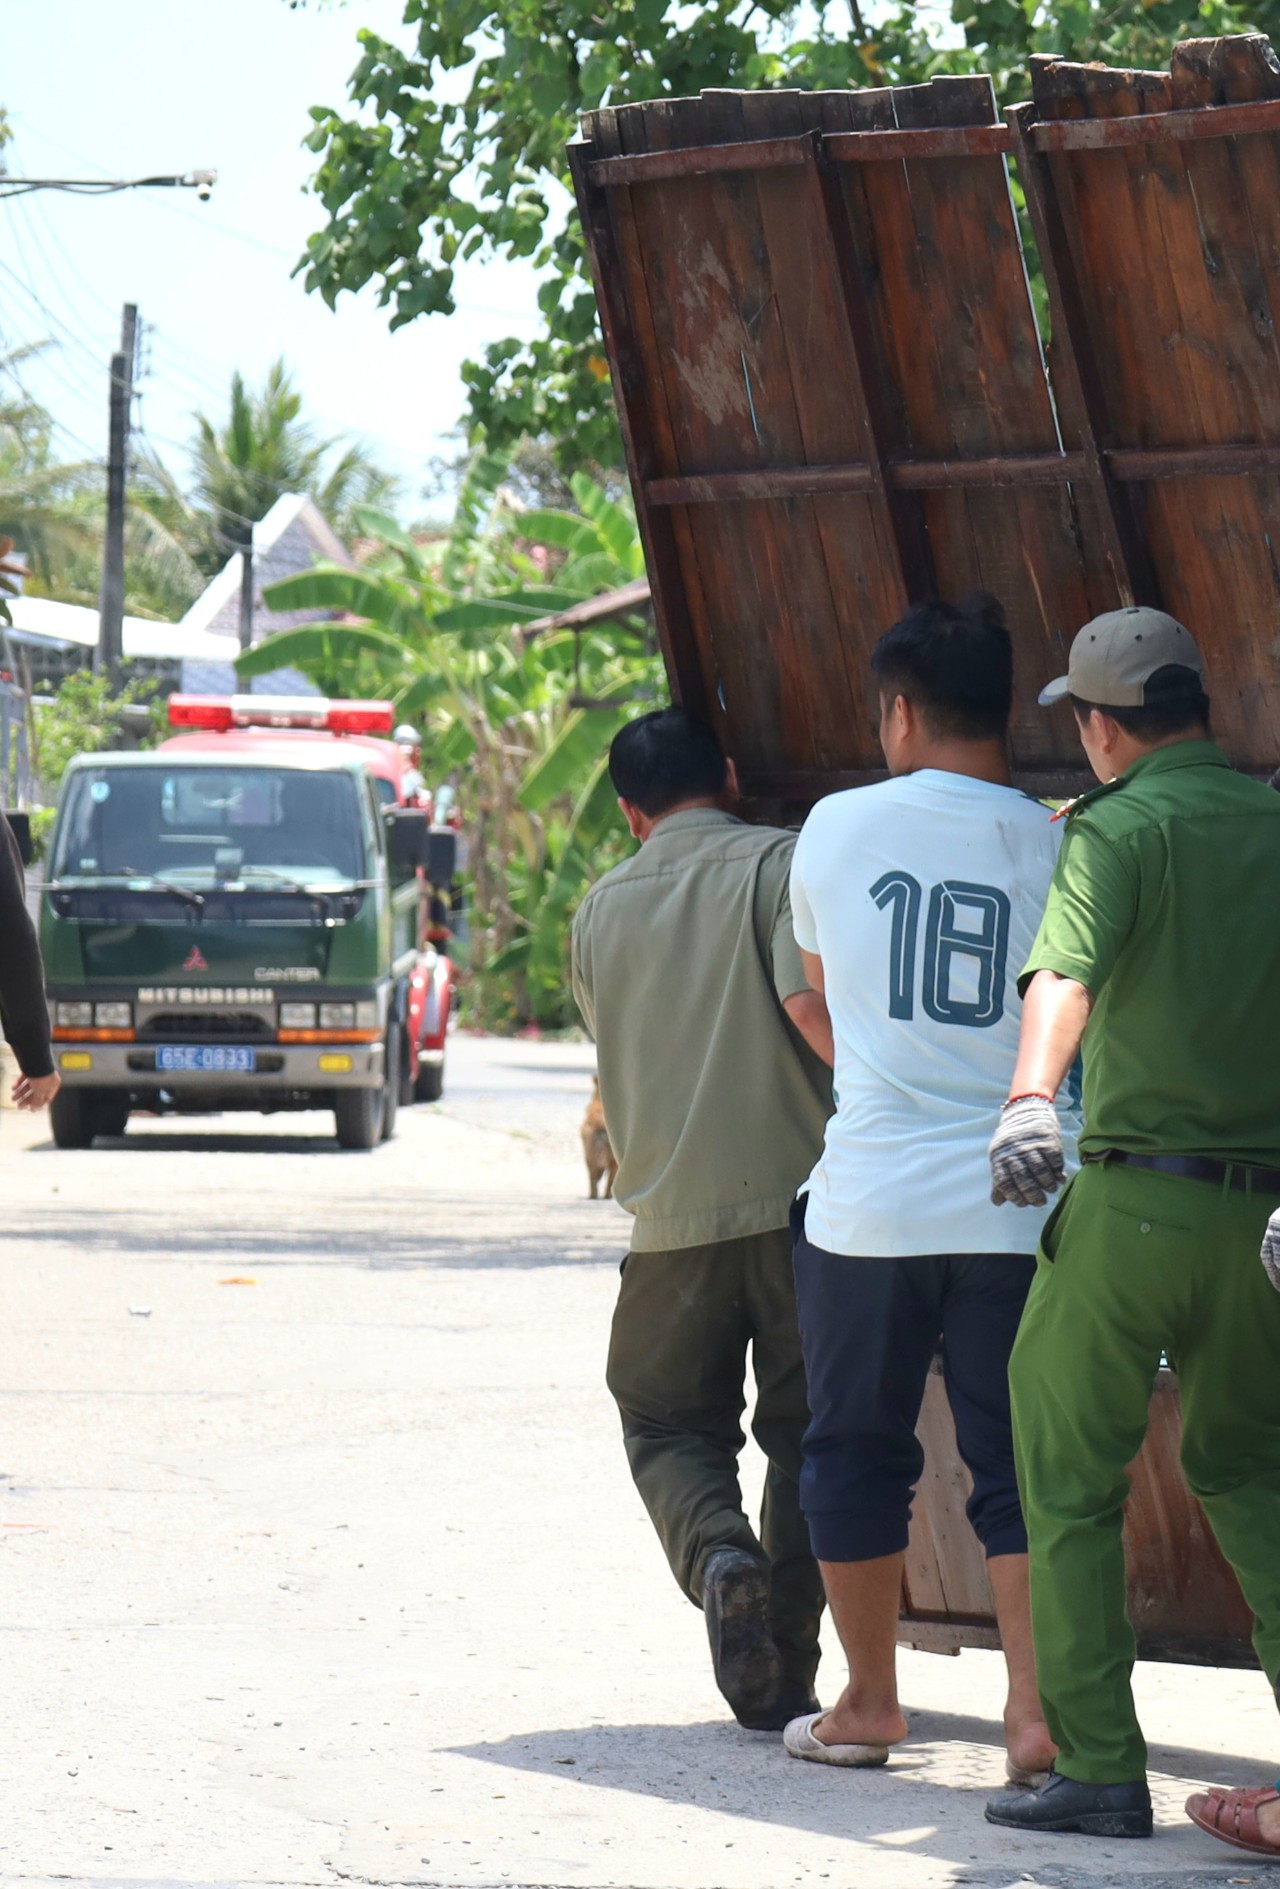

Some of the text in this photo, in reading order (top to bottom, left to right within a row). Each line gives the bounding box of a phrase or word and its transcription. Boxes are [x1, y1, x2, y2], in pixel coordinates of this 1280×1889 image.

[868, 870, 1011, 1028] 18
[254, 966, 321, 982] CANTER
[137, 986, 275, 1004] MITSUBISHI
